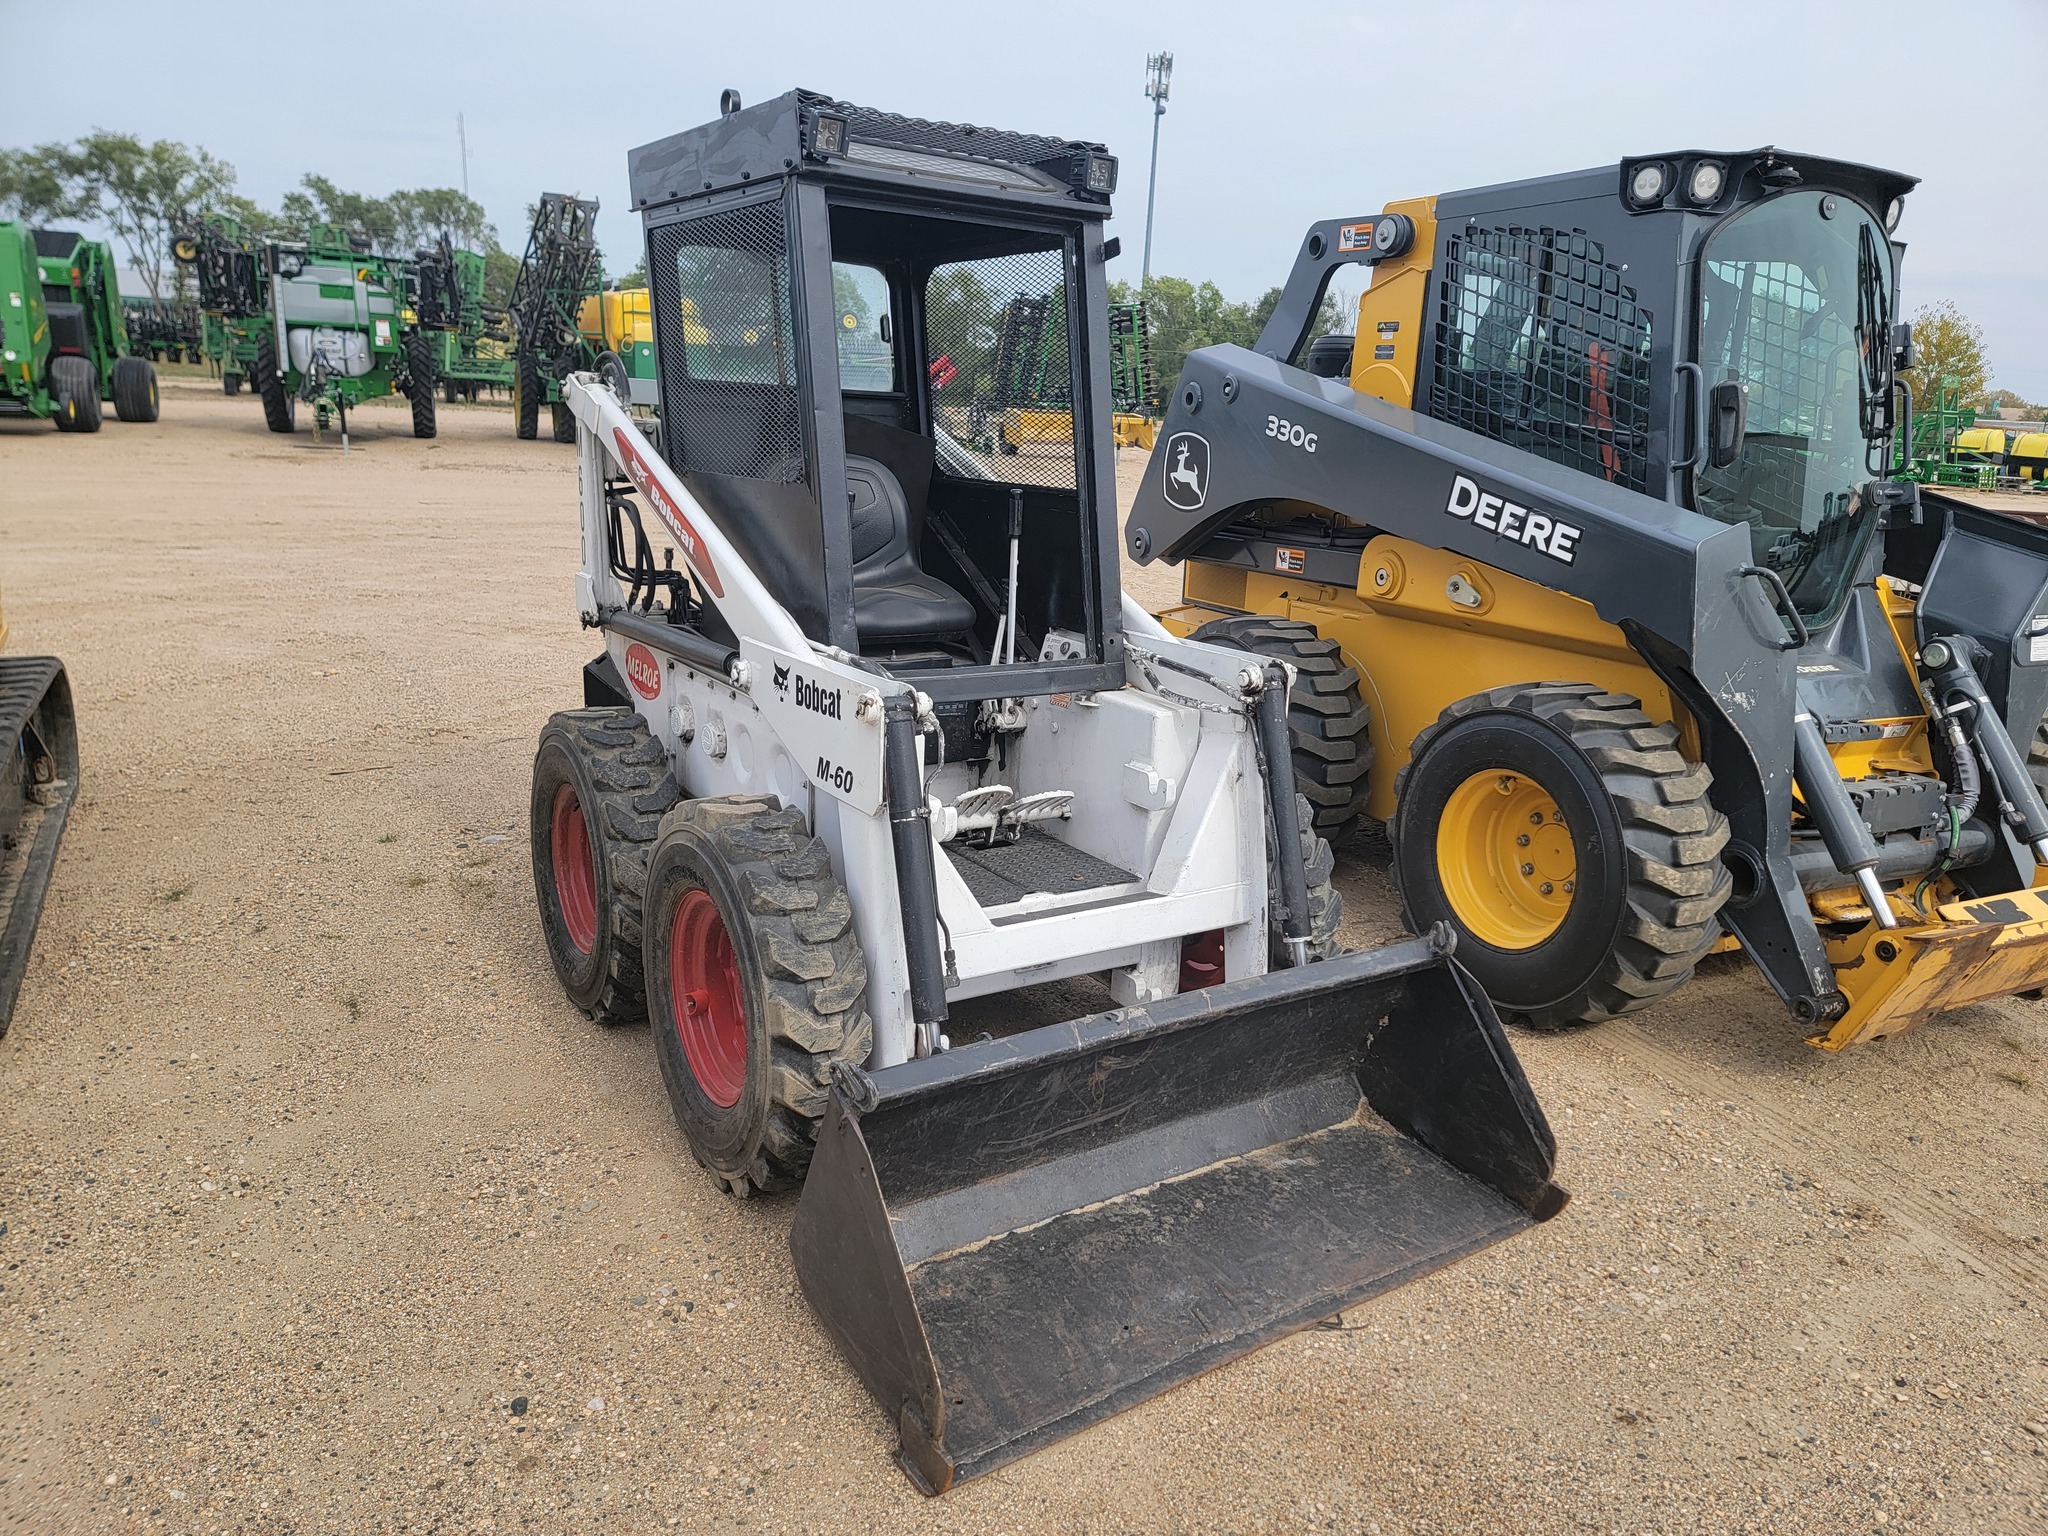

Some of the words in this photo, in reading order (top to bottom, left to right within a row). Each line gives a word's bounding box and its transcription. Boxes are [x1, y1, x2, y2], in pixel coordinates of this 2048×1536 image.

[1265, 415, 1318, 453] 330G
[651, 485, 694, 554] Bobcat
[1447, 475, 1581, 563] DEERE
[627, 654, 659, 690] MELROE
[795, 674, 842, 721] Bobcat
[816, 756, 854, 794] M-60
